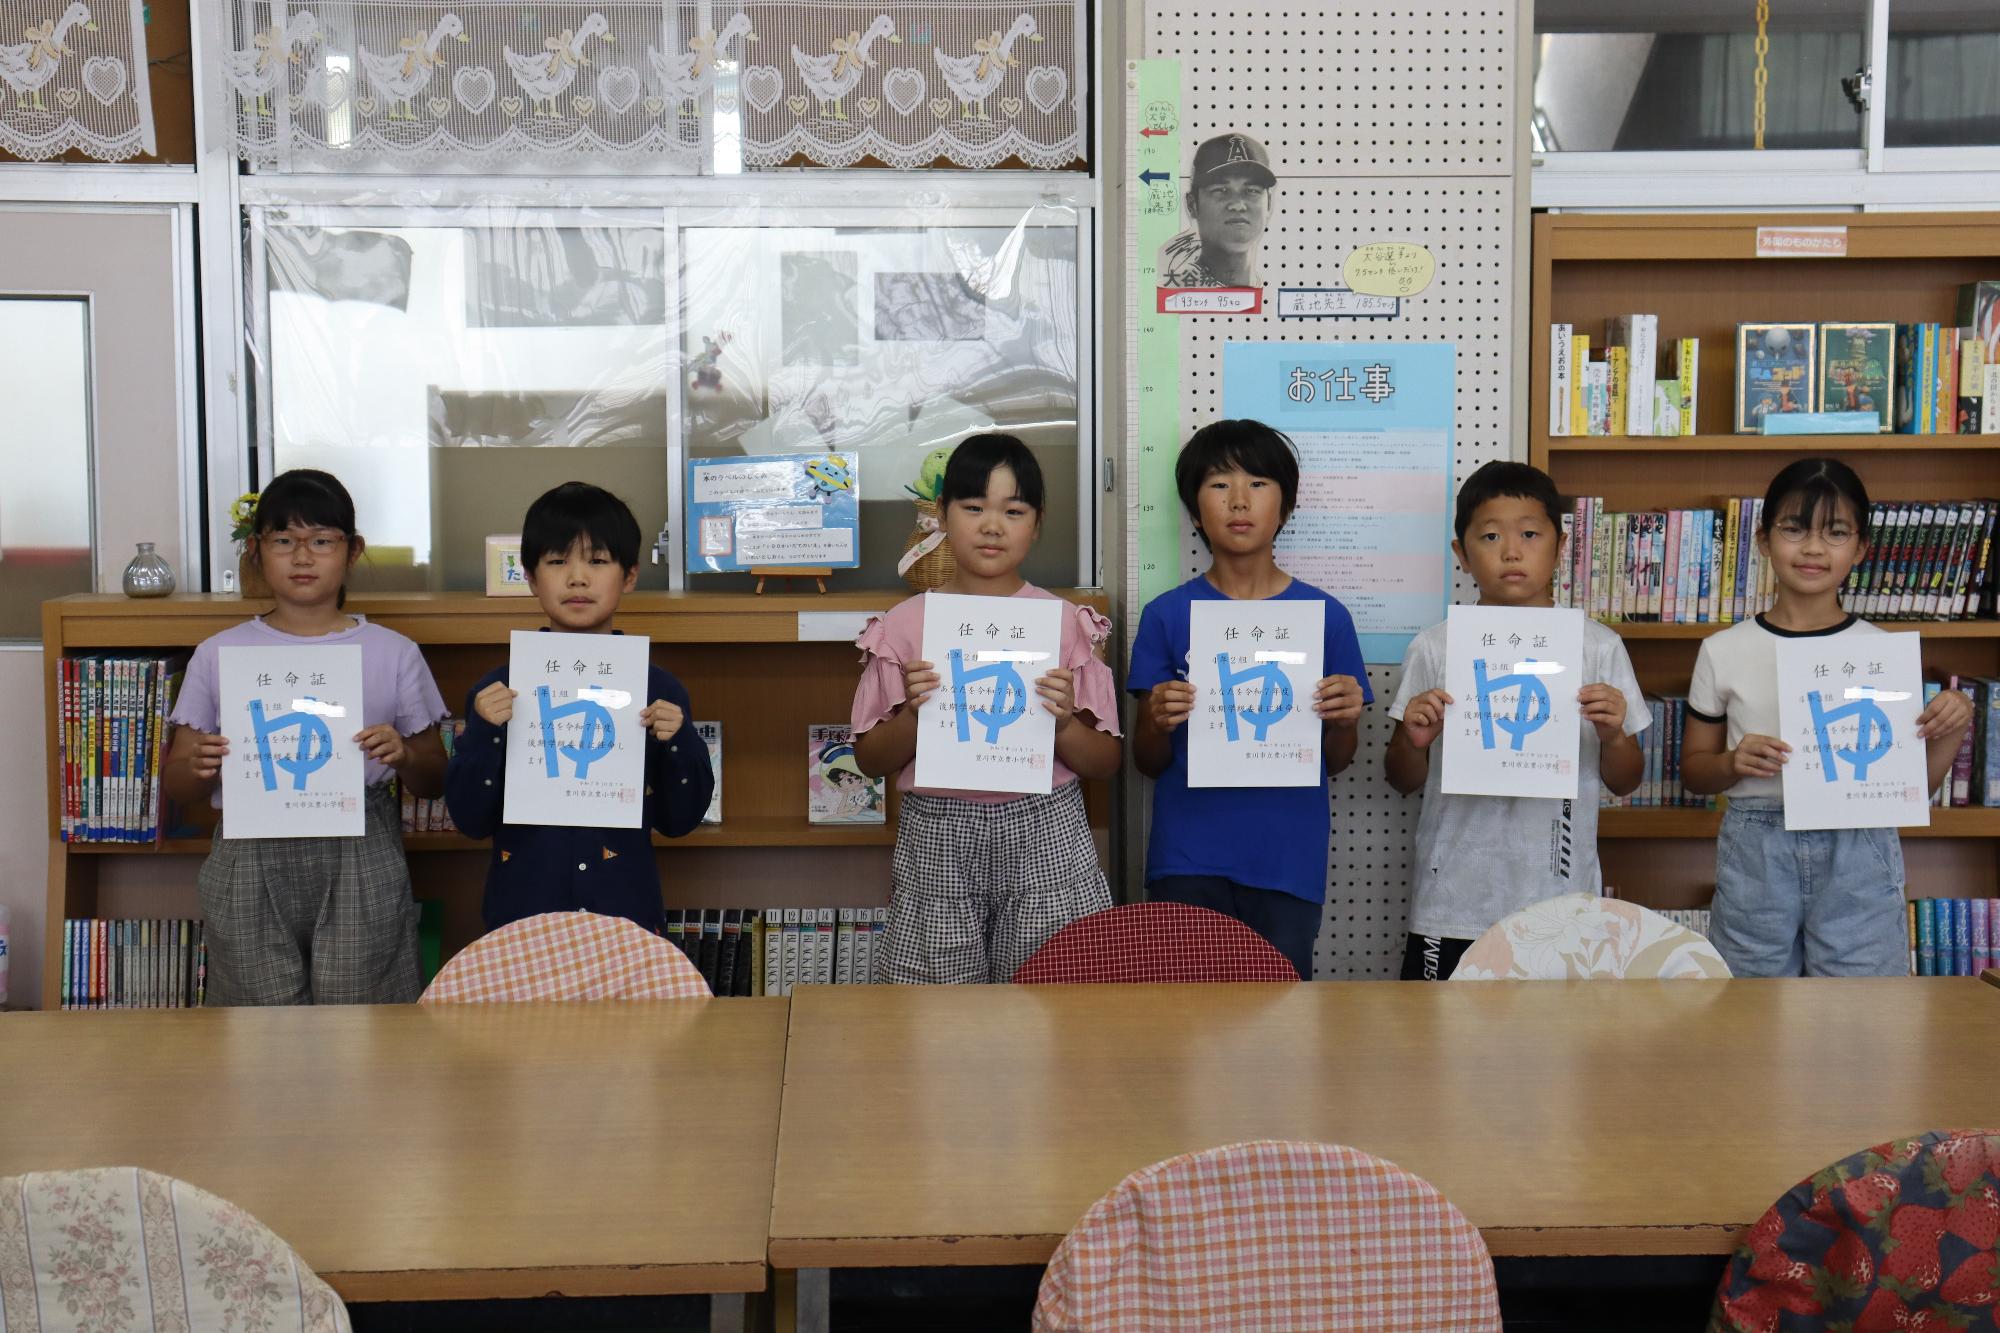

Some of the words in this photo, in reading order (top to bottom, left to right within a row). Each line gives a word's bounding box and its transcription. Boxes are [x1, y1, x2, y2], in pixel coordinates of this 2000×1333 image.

[1557, 323, 1566, 381] あいうえおの本
[1288, 363, 1395, 403] お仕事
[958, 622, 1028, 640] 任命証
[1224, 625, 1290, 642] 任命証
[1481, 632, 1549, 649] 任命証
[546, 659, 613, 676] 任命証
[1814, 661, 1885, 678] 任命証
[256, 671, 327, 687] 任命証
[770, 911, 777, 920] 11
[788, 911, 796, 920] 12
[805, 911, 813, 920] 13
[822, 911, 829, 920] 14
[842, 910, 850, 919] 15
[860, 910, 867, 920] 16
[876, 910, 883, 919] 17
[769, 934, 779, 964] BLACK
[786, 934, 796, 964] BLACK
[803, 934, 813, 964] BLACK
[819, 934, 829, 964] BLACK
[840, 933, 850, 963] BLACK
[857, 933, 867, 963] BLACK
[767, 966, 778, 987] JACK
[785, 966, 796, 987] JACK
